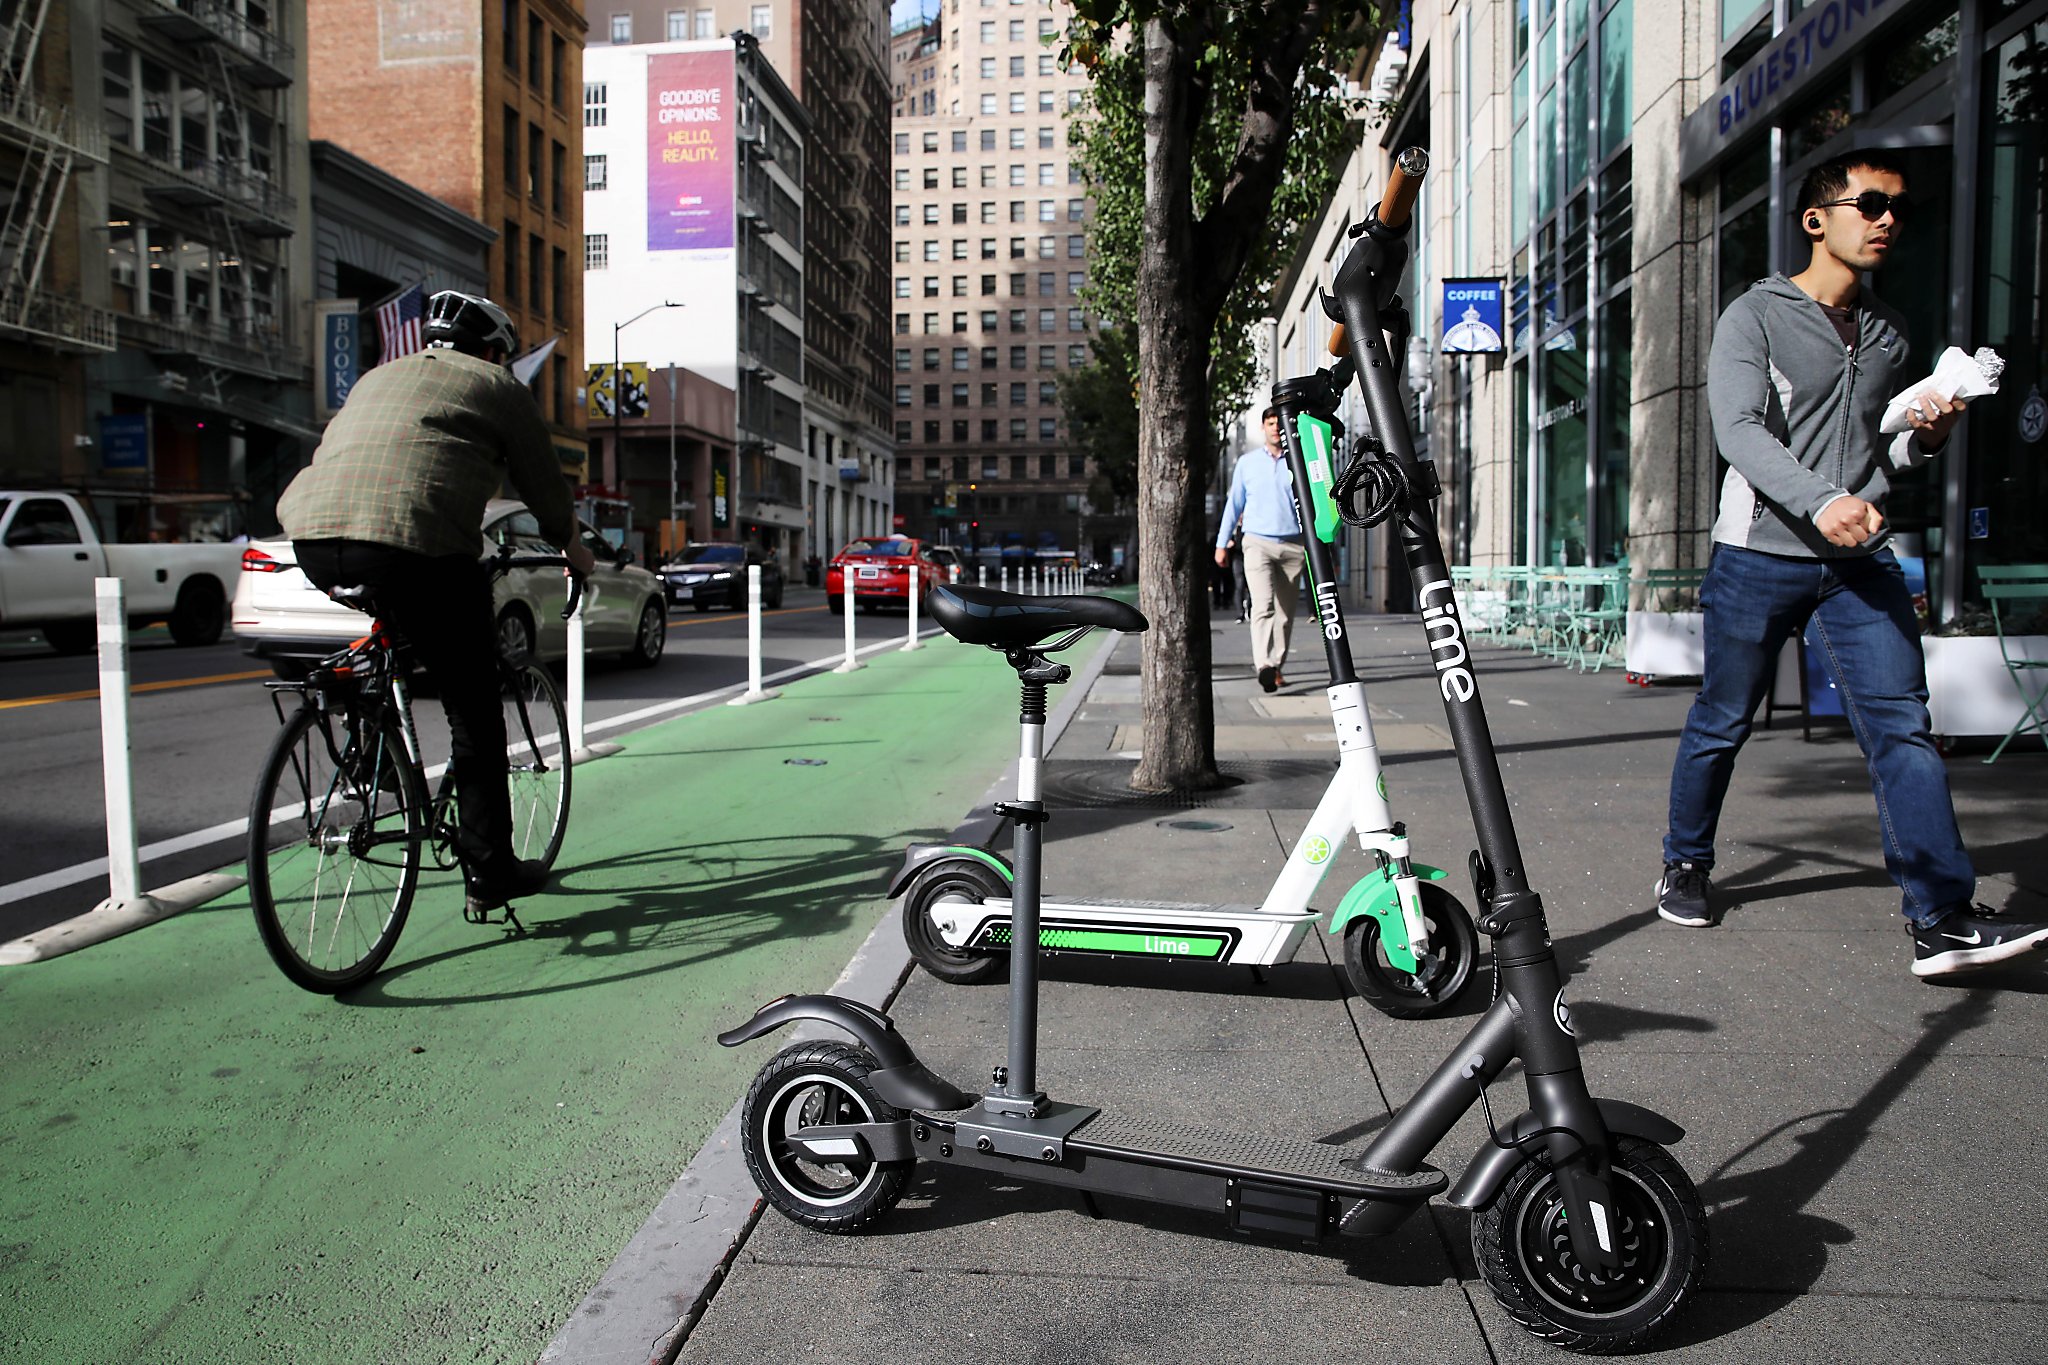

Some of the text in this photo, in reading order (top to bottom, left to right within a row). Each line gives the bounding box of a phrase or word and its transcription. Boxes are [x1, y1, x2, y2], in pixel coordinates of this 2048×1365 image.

[1719, 0, 1886, 136] BLUESTON
[659, 88, 720, 105] GOODBYE
[658, 107, 721, 124] OPINIONS.
[662, 147, 719, 163] REALITY.
[1447, 290, 1496, 301] COFFEE
[334, 316, 349, 406] BOOKS
[1315, 581, 1342, 641] Lime
[1419, 579, 1475, 703] Lime
[1145, 935, 1190, 955] Lime
